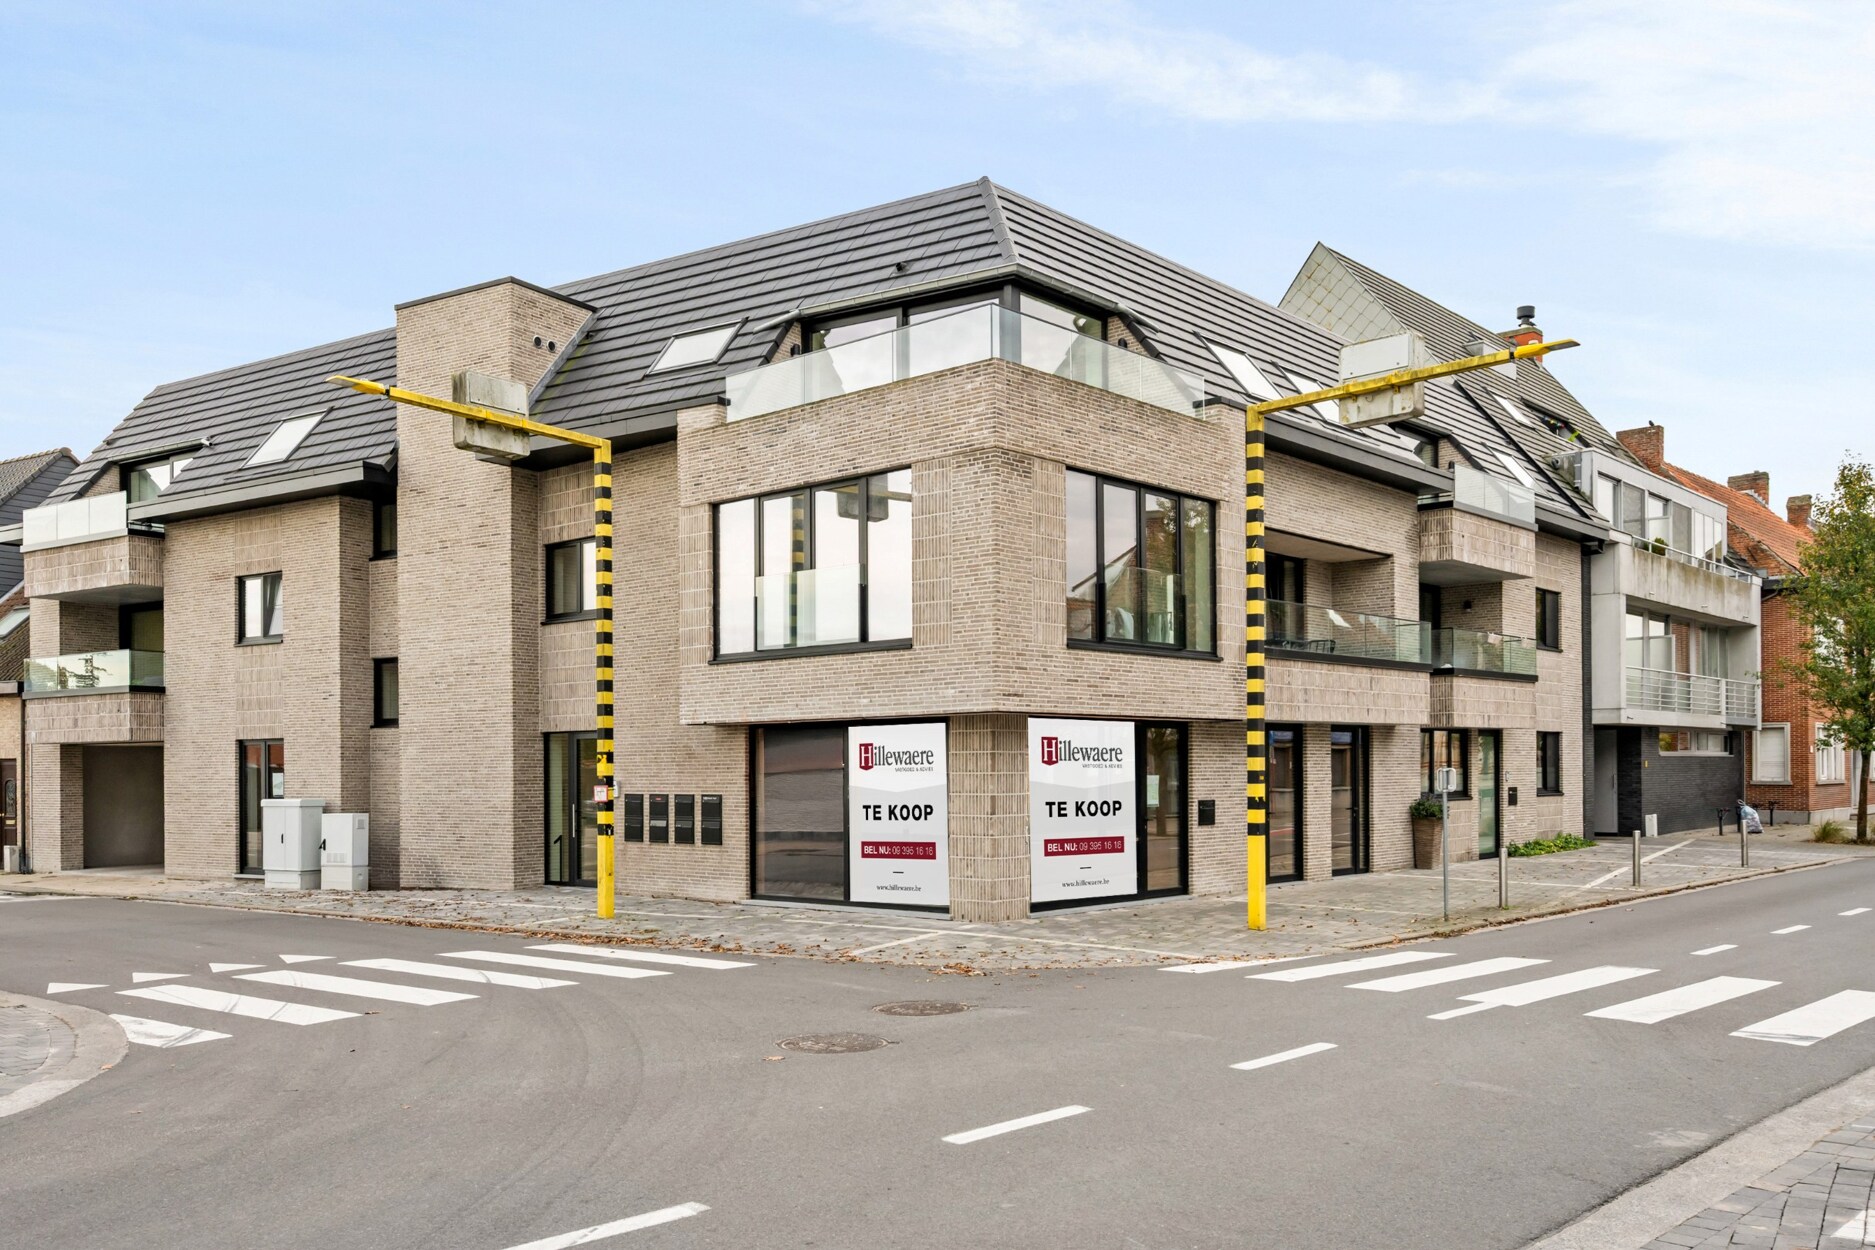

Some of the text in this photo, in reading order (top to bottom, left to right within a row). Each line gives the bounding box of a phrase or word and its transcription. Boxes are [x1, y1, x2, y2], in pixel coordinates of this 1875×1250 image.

[860, 745, 934, 767] Hillewaere
[1043, 739, 1123, 762] Hillewaere
[862, 804, 934, 821] TE KOOP
[1045, 800, 1122, 818] TE KOOP
[864, 845, 878, 854] BEL
[879, 845, 891, 855] NU:
[1047, 843, 1063, 852] BEL
[1064, 842, 1078, 851] NU:
